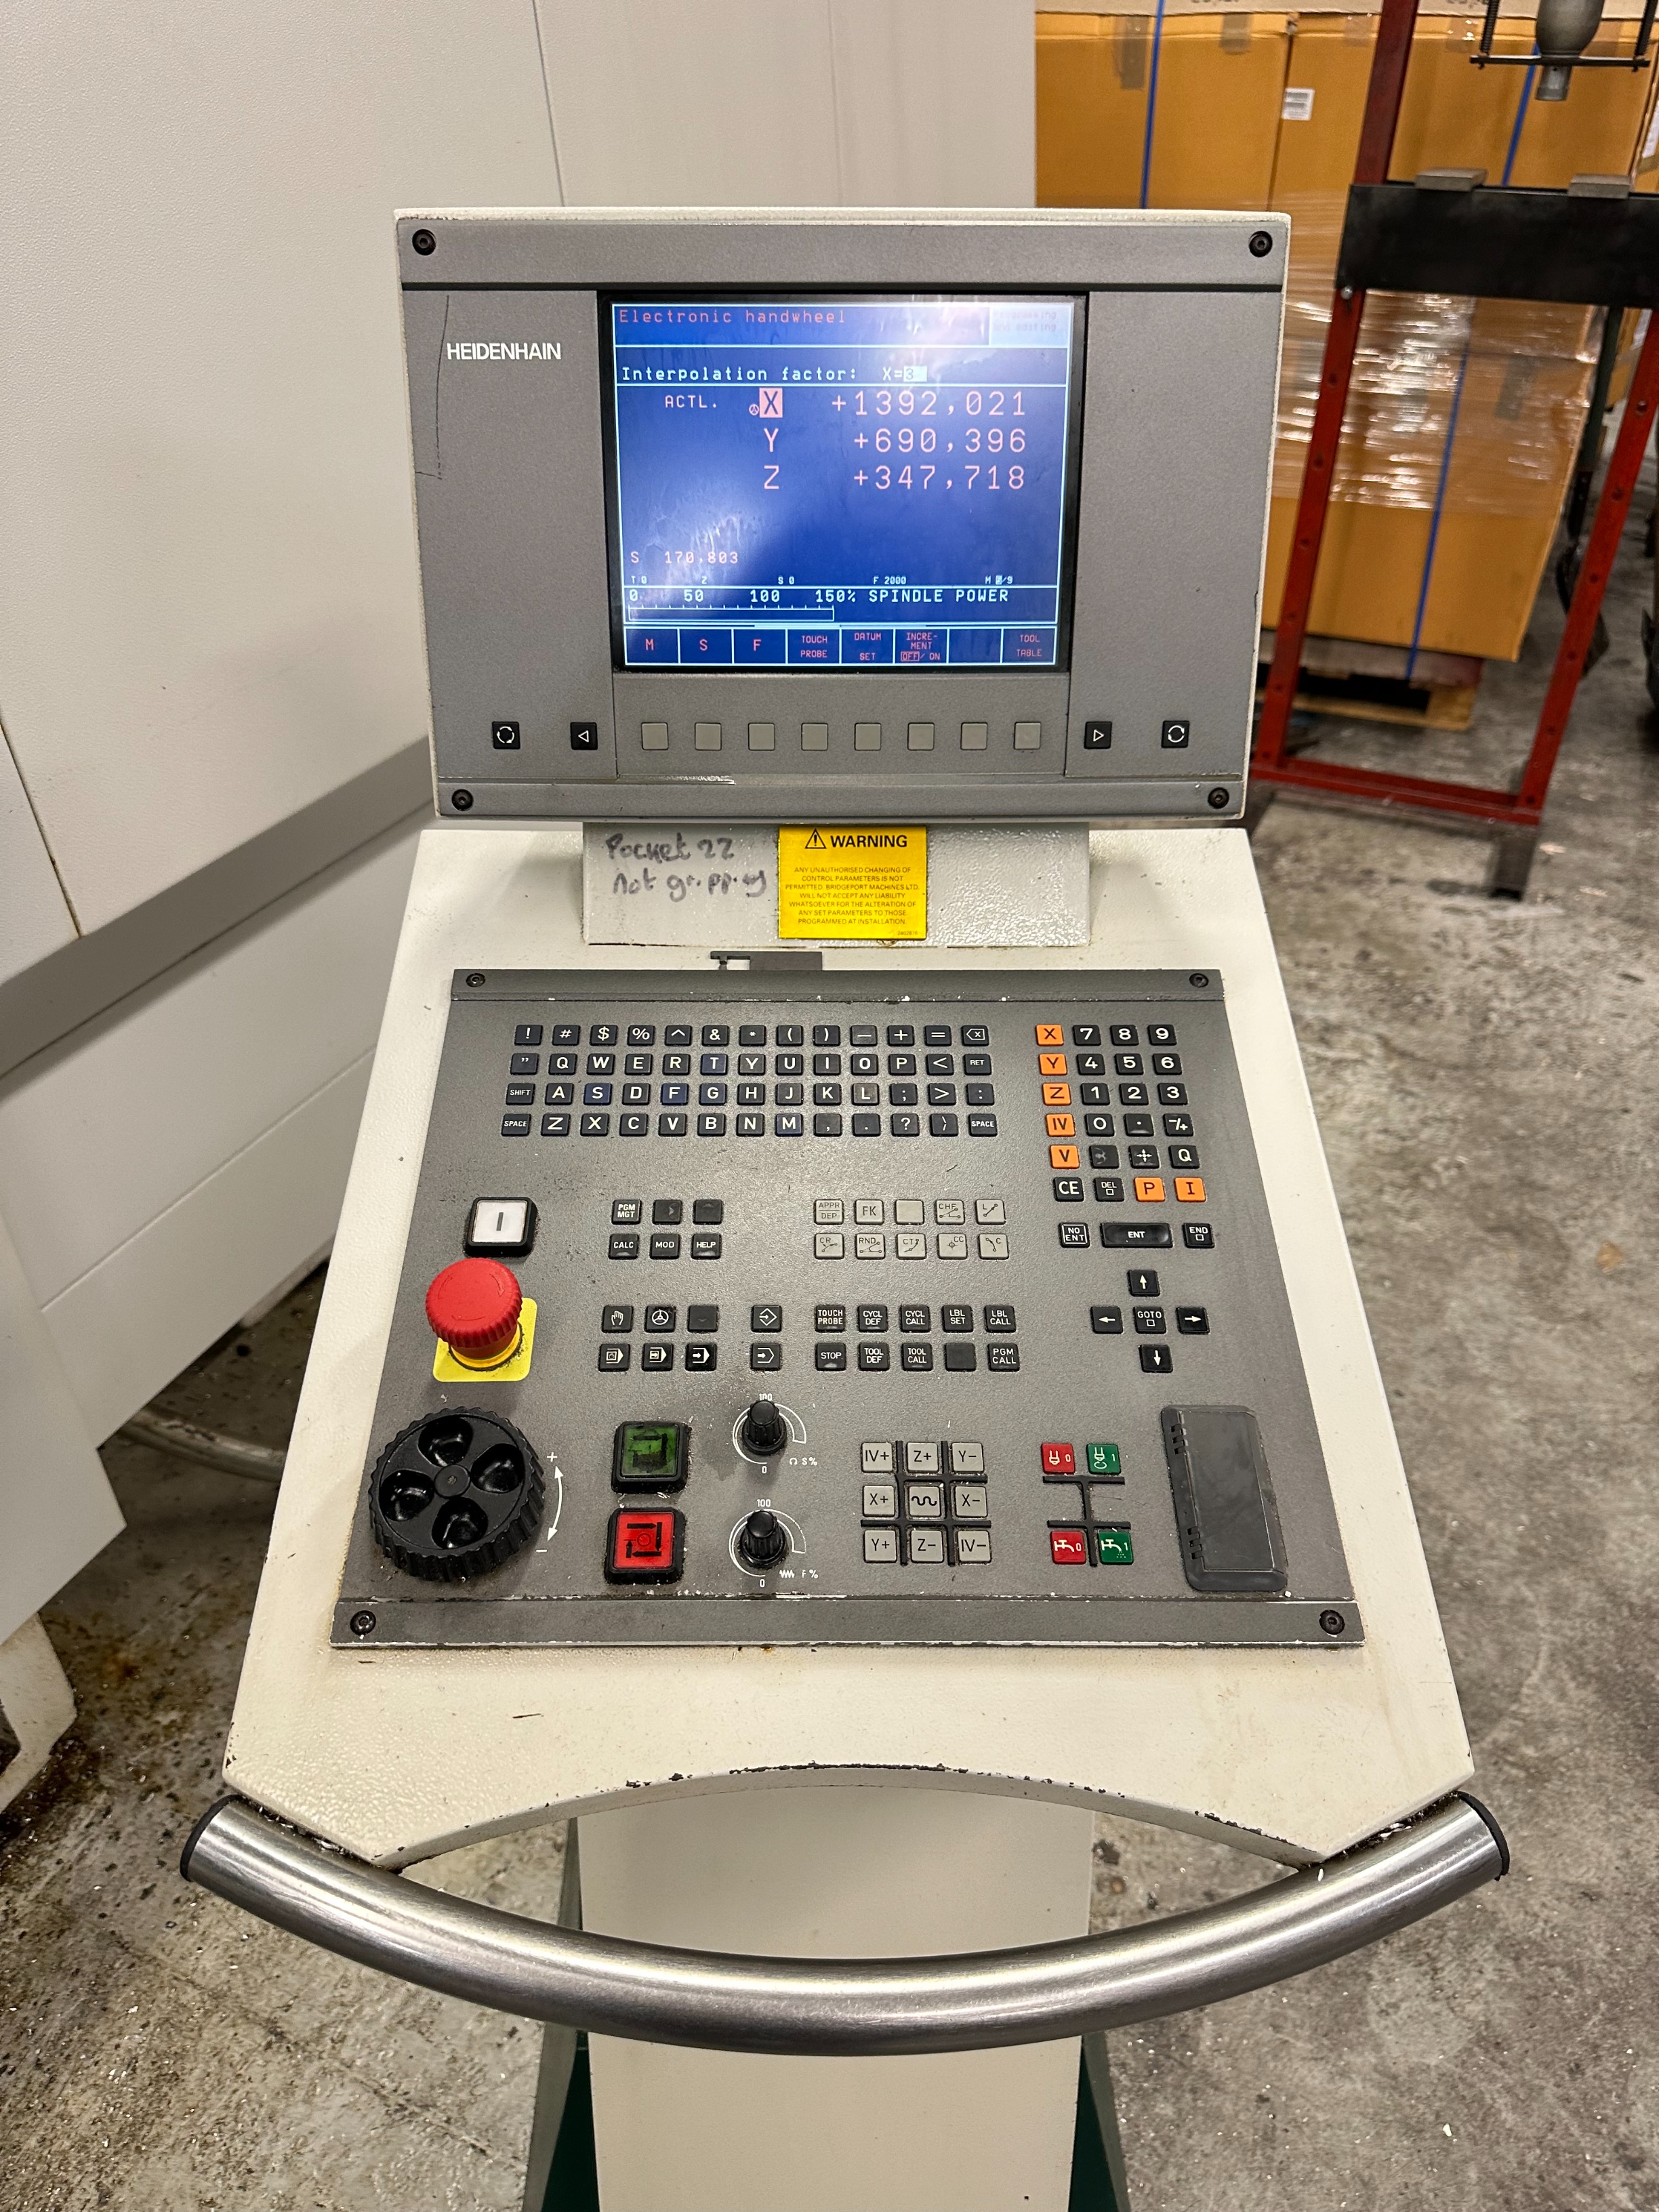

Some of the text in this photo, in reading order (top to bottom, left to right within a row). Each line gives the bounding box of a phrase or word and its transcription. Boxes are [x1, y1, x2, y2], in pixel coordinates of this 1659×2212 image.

[619, 310, 844, 323] Electronic handwheel
[447, 343, 561, 360] HEIDENHAIN
[622, 367, 914, 381] Interpolation factor: X=3
[665, 390, 1025, 415] ACTL. X +1392,021
[764, 428, 1025, 453] Y +690,396
[764, 465, 1024, 490] Z +347,718
[630, 551, 738, 564] S 170,803
[630, 590, 1008, 602] 0 50 100 150% SPINDLE POWER
[801, 636, 827, 644] TOUCH
[854, 632, 881, 641] DATUM
[1020, 634, 1040, 642] TOOL
[645, 639, 654, 651] M
[699, 639, 708, 651] S
[753, 639, 761, 651] F
[910, 642, 932, 650] MENT
[800, 650, 827, 658] PROBE
[859, 653, 876, 661] SET
[1017, 649, 1042, 657] TABLE
[831, 835, 907, 847] WARNING
[1044, 1028, 1168, 1040] X 7 8 9
[557, 1057, 568, 1069] Q
[593, 1057, 609, 1068] W
[634, 1057, 644, 1069] E
[670, 1057, 681, 1068] R
[710, 1057, 718, 1069] T
[745, 1058, 758, 1069] Y
[785, 1057, 795, 1069] U
[859, 1058, 870, 1069] O
[897, 1058, 907, 1069] P
[1046, 1057, 1174, 1069] Y 4 5 6
[1050, 1086, 1179, 1099] Z 1 2 3
[1059, 1181, 1079, 1194] CE
[863, 1206, 876, 1216] FK
[757, 1499, 771, 1507] 100
